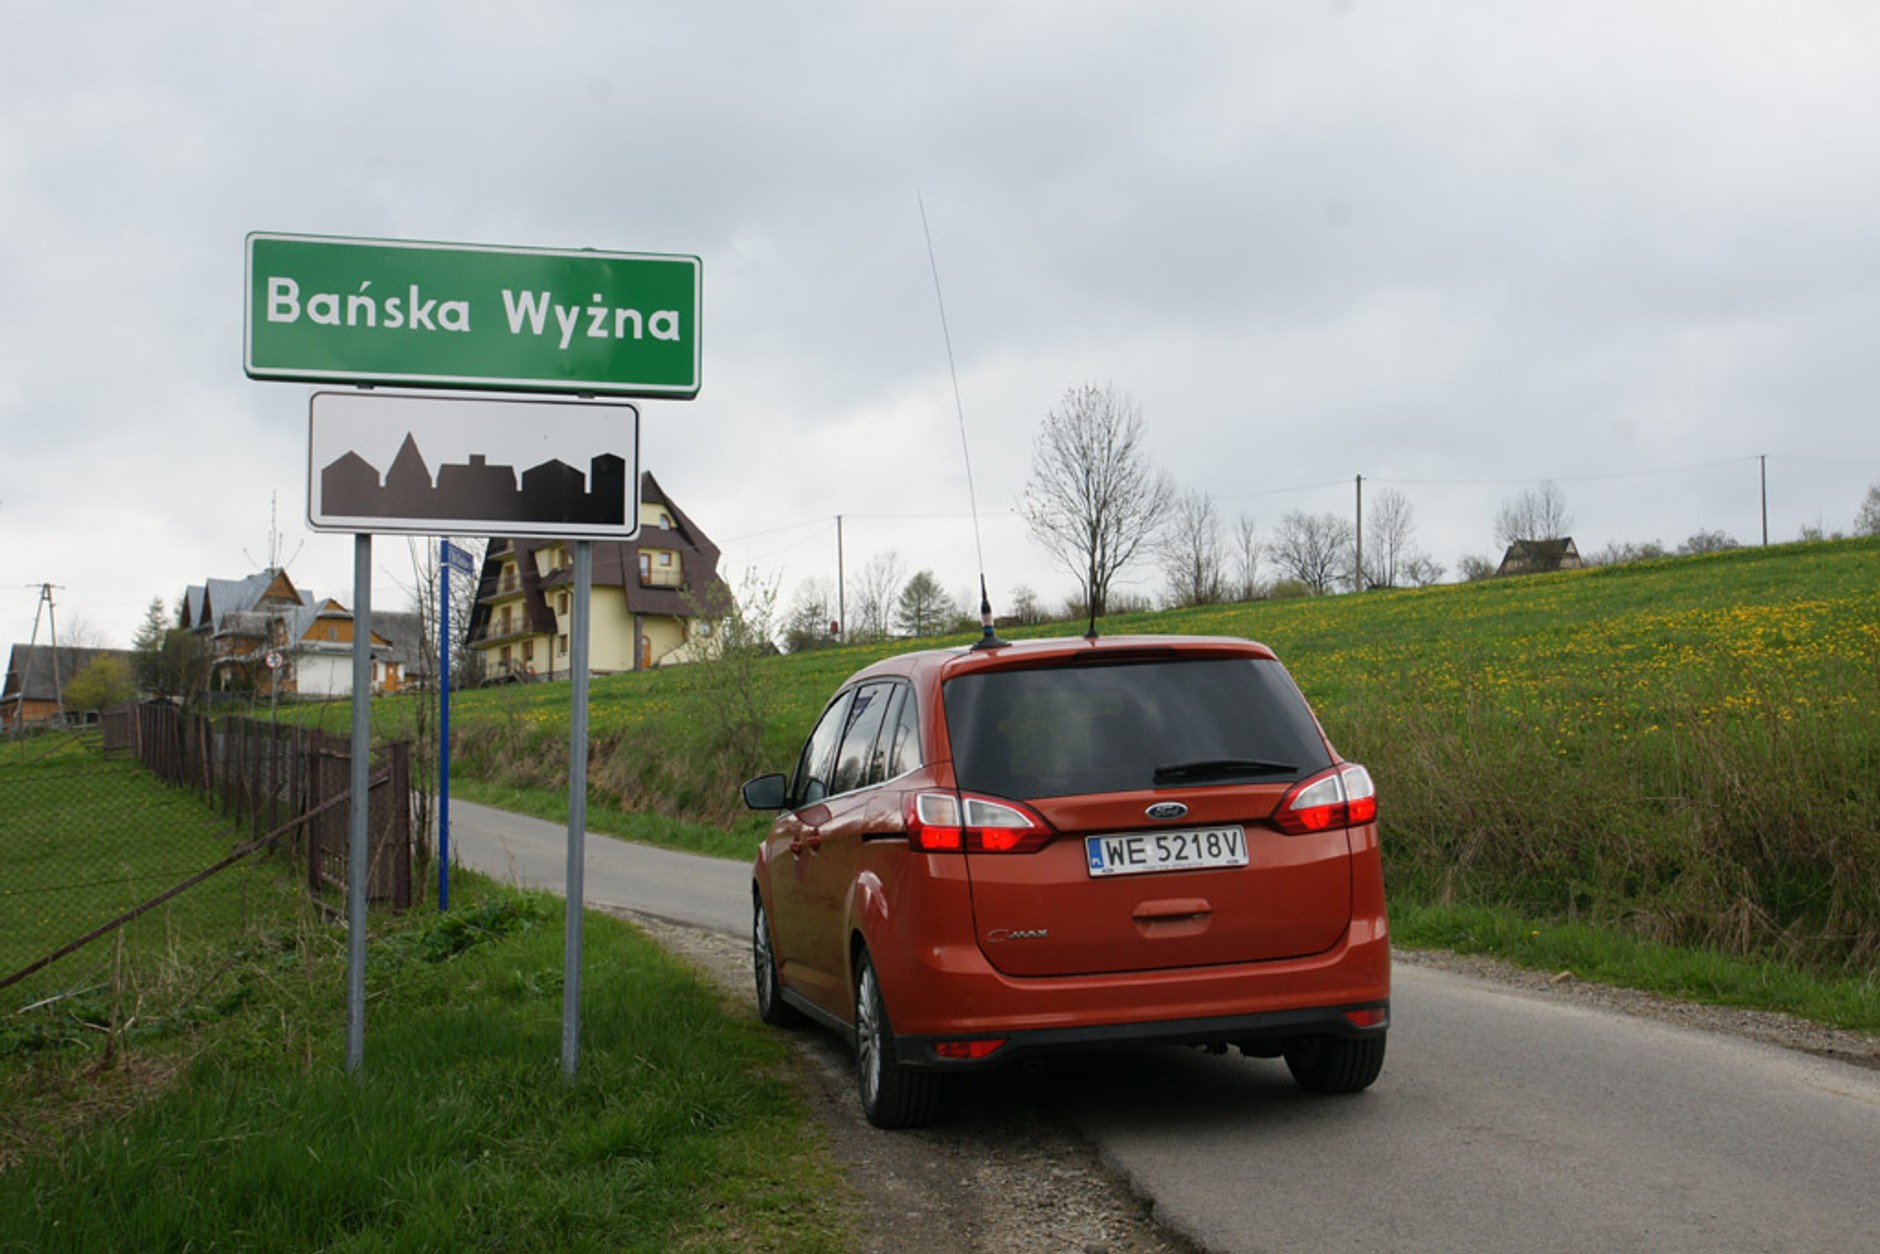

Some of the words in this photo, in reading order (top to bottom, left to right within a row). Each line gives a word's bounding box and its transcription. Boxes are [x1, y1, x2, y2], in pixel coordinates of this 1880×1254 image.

[267, 276, 471, 332] Bańska
[501, 289, 681, 350] Wyżna
[1105, 837, 1147, 866] WE
[1155, 831, 1238, 863] 5218V
